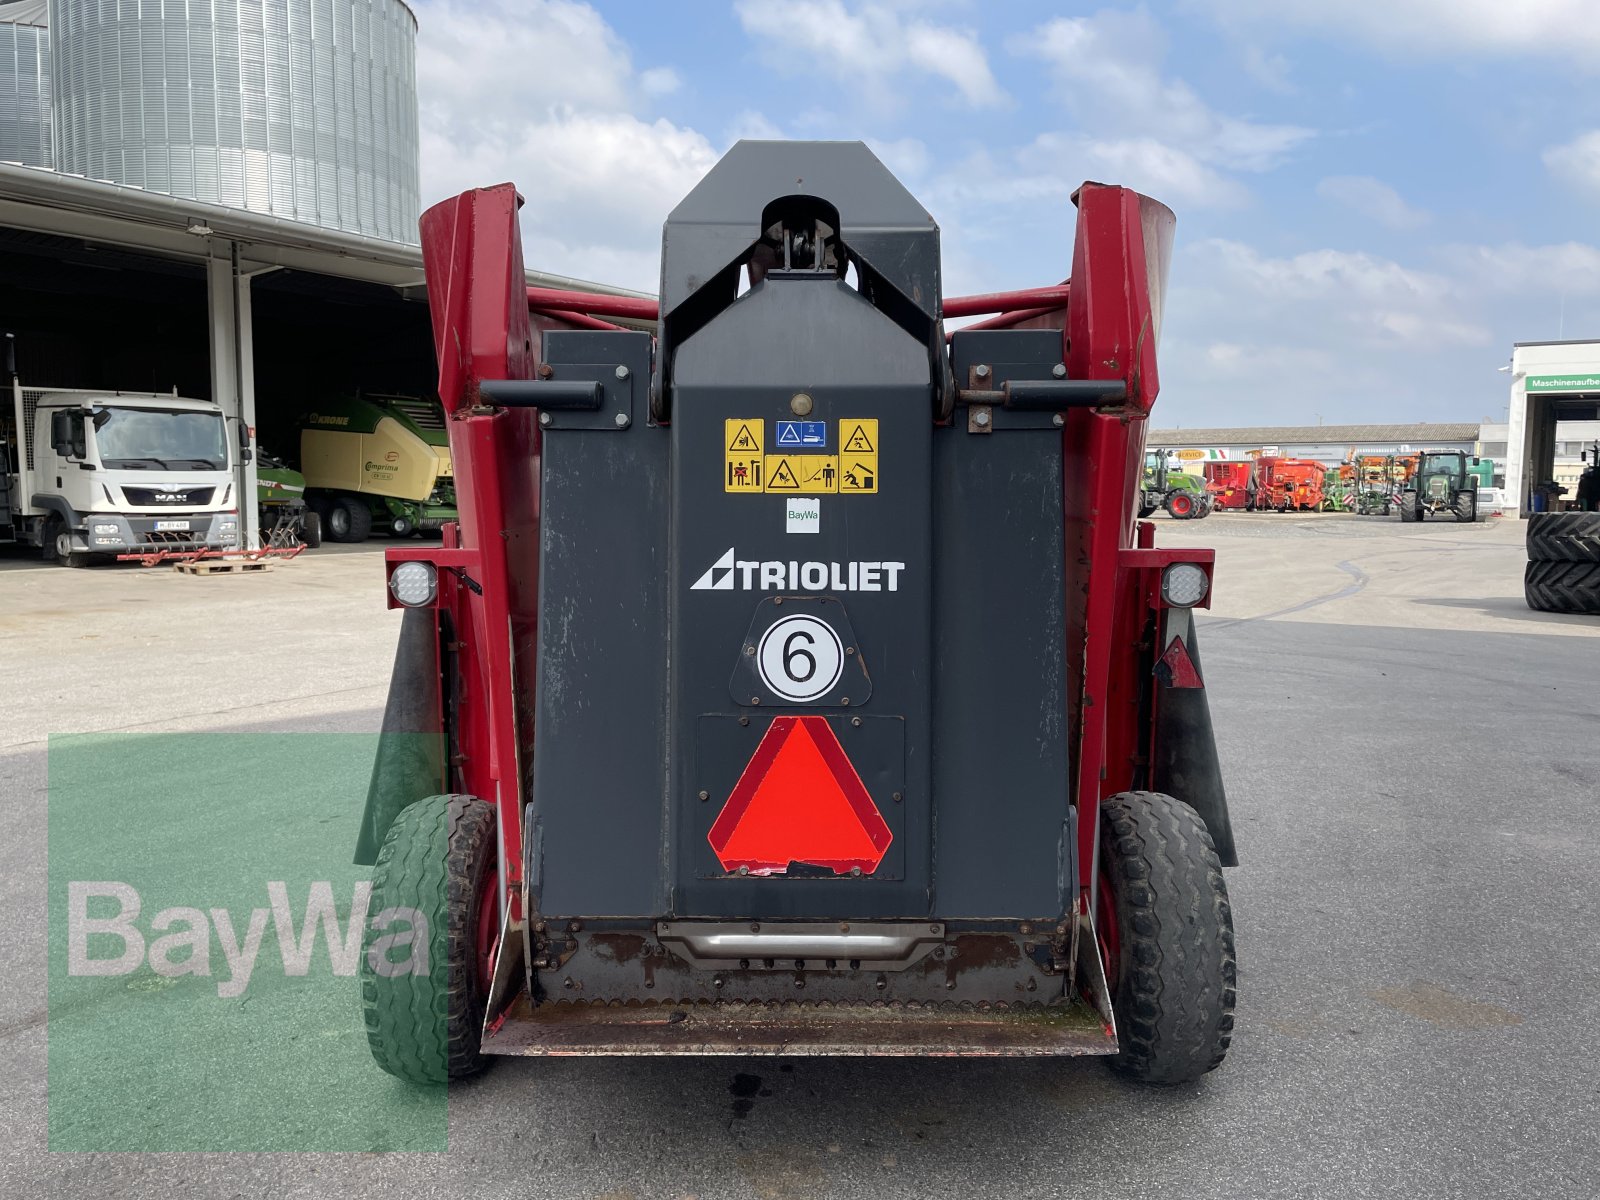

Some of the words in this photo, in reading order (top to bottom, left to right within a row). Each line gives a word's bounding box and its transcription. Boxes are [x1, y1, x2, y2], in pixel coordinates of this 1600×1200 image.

[318, 415, 349, 425] KRONE
[256, 479, 278, 488] ENDT
[154, 494, 187, 502] MAN
[788, 511, 818, 520] BayWa
[736, 560, 905, 591] TRIOLIET
[783, 631, 816, 683] 6
